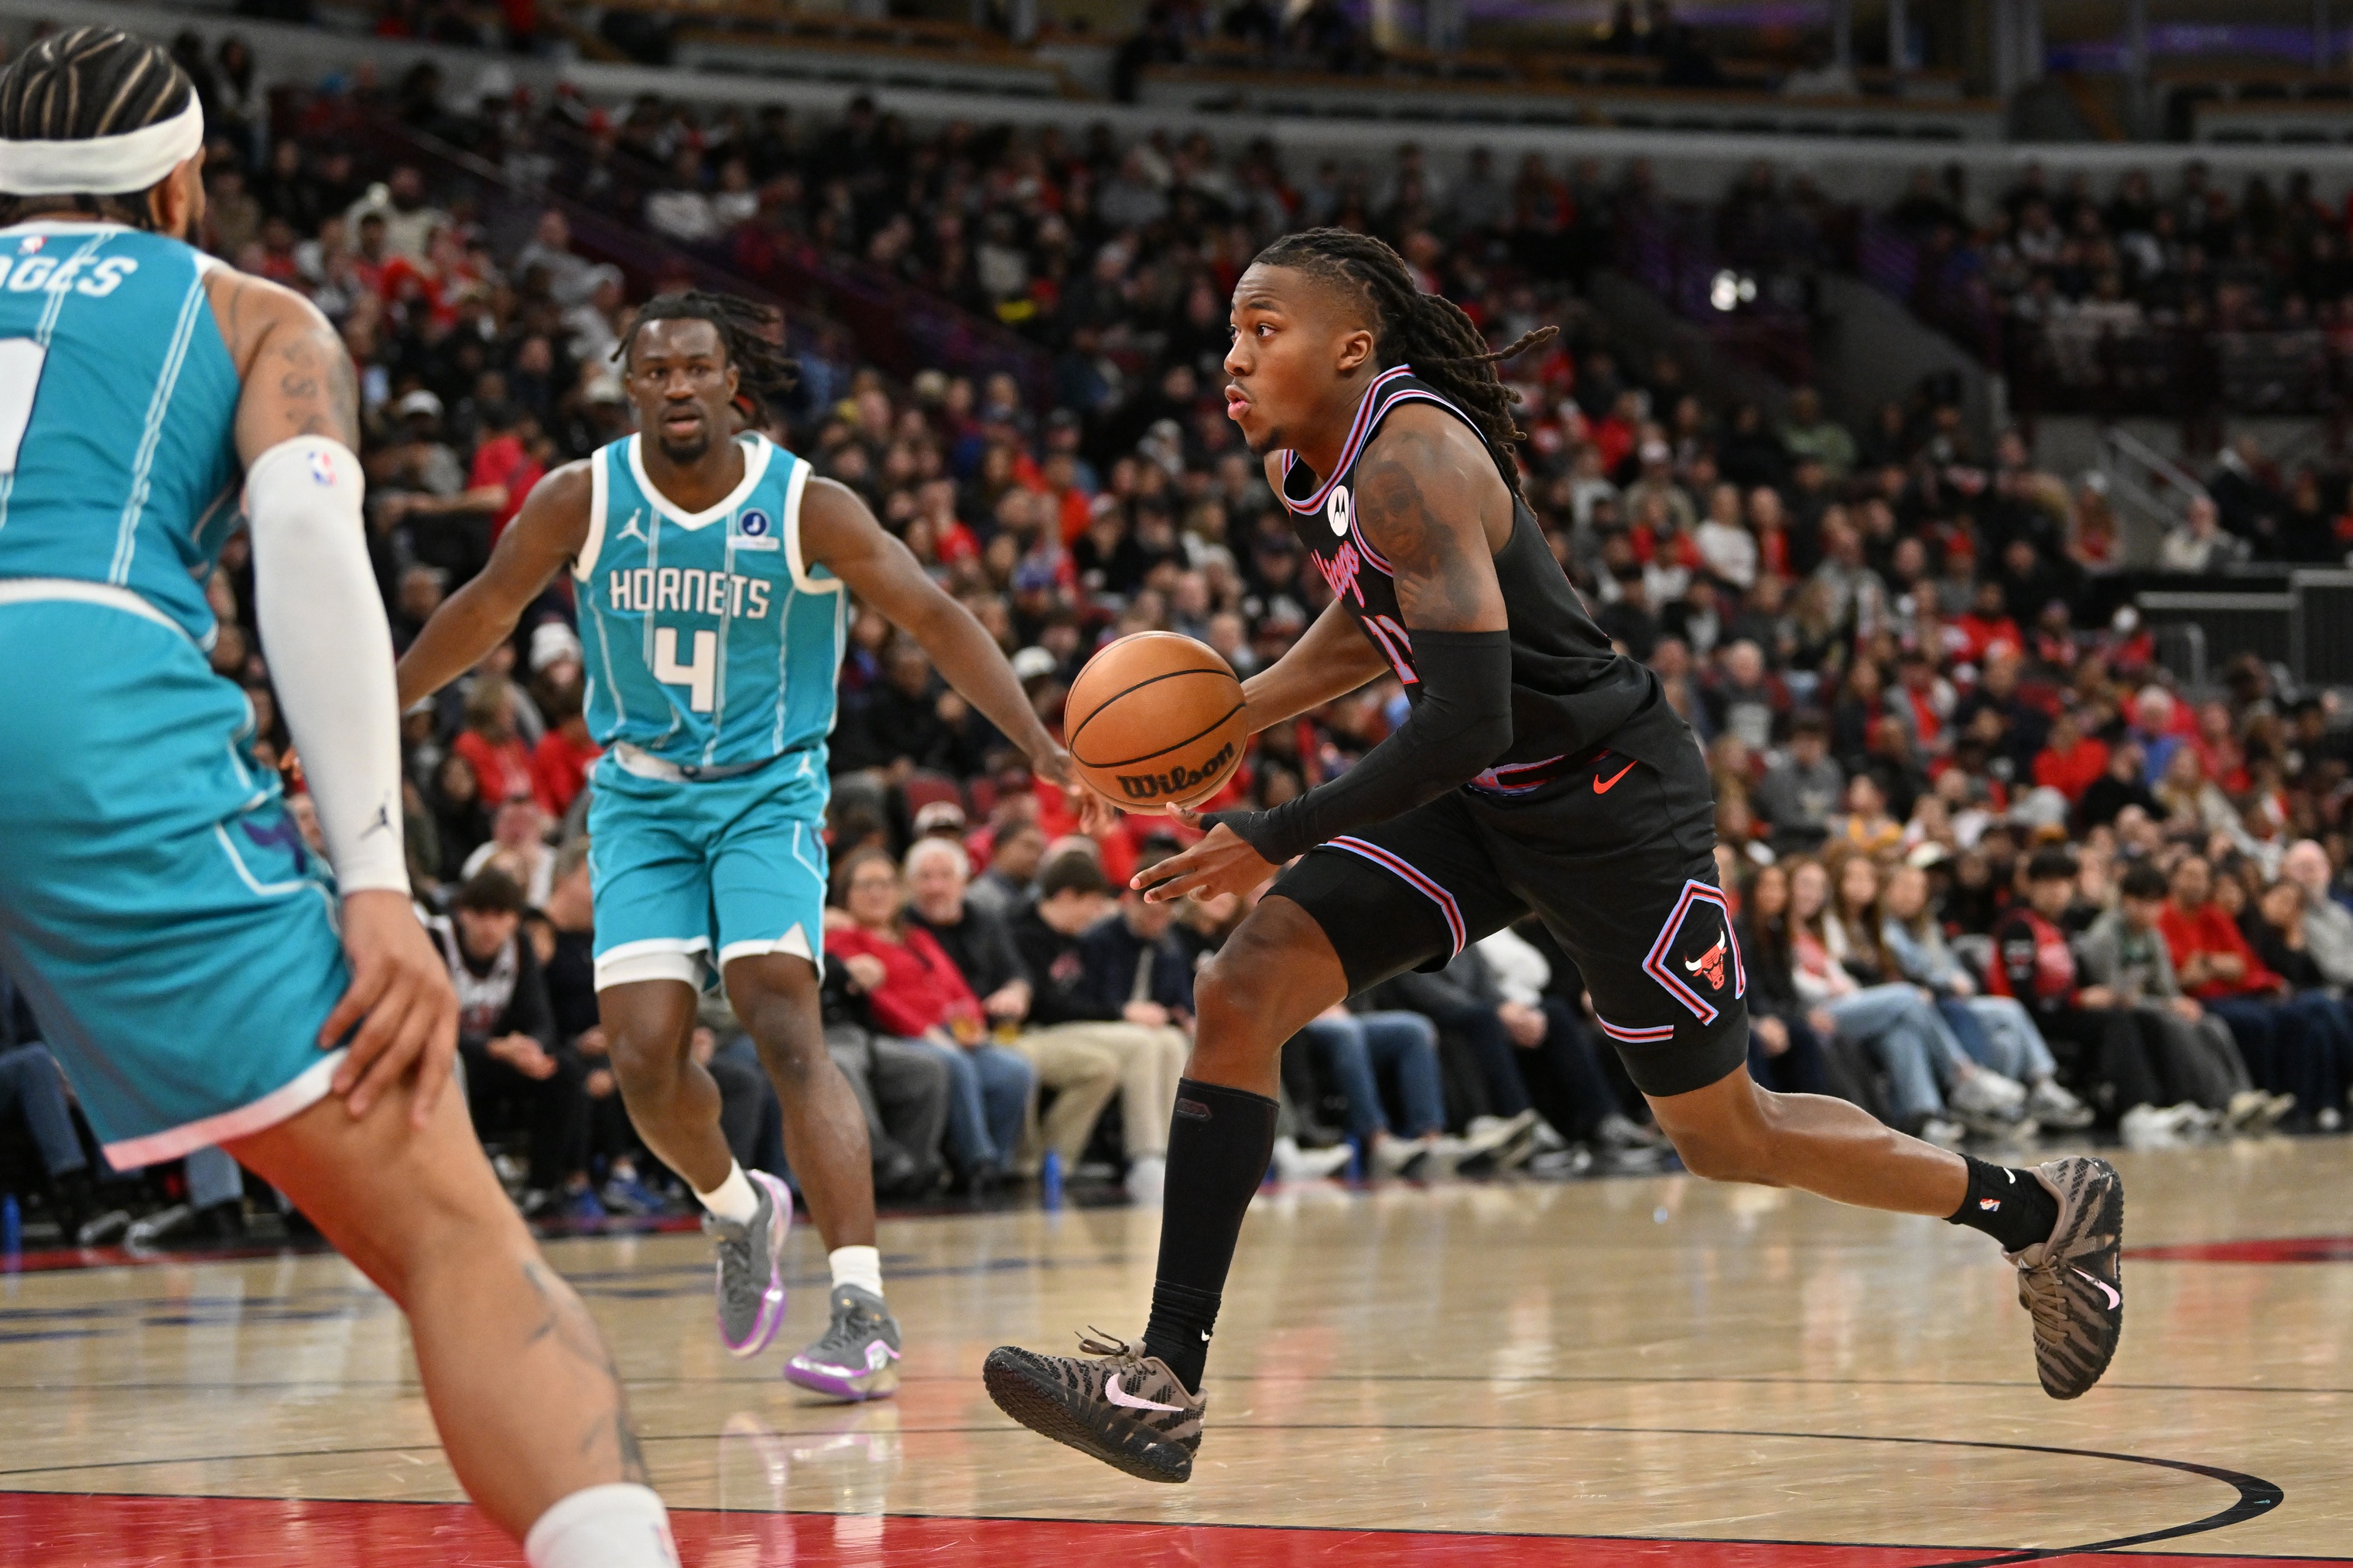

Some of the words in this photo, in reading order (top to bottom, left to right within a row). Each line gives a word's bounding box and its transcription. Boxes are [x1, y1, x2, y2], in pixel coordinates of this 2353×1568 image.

[0, 255, 139, 297] GES
[610, 567, 771, 619] HORNETS
[1311, 541, 1365, 608] icago
[654, 627, 717, 713] 4
[1116, 741, 1234, 799] Wilson
